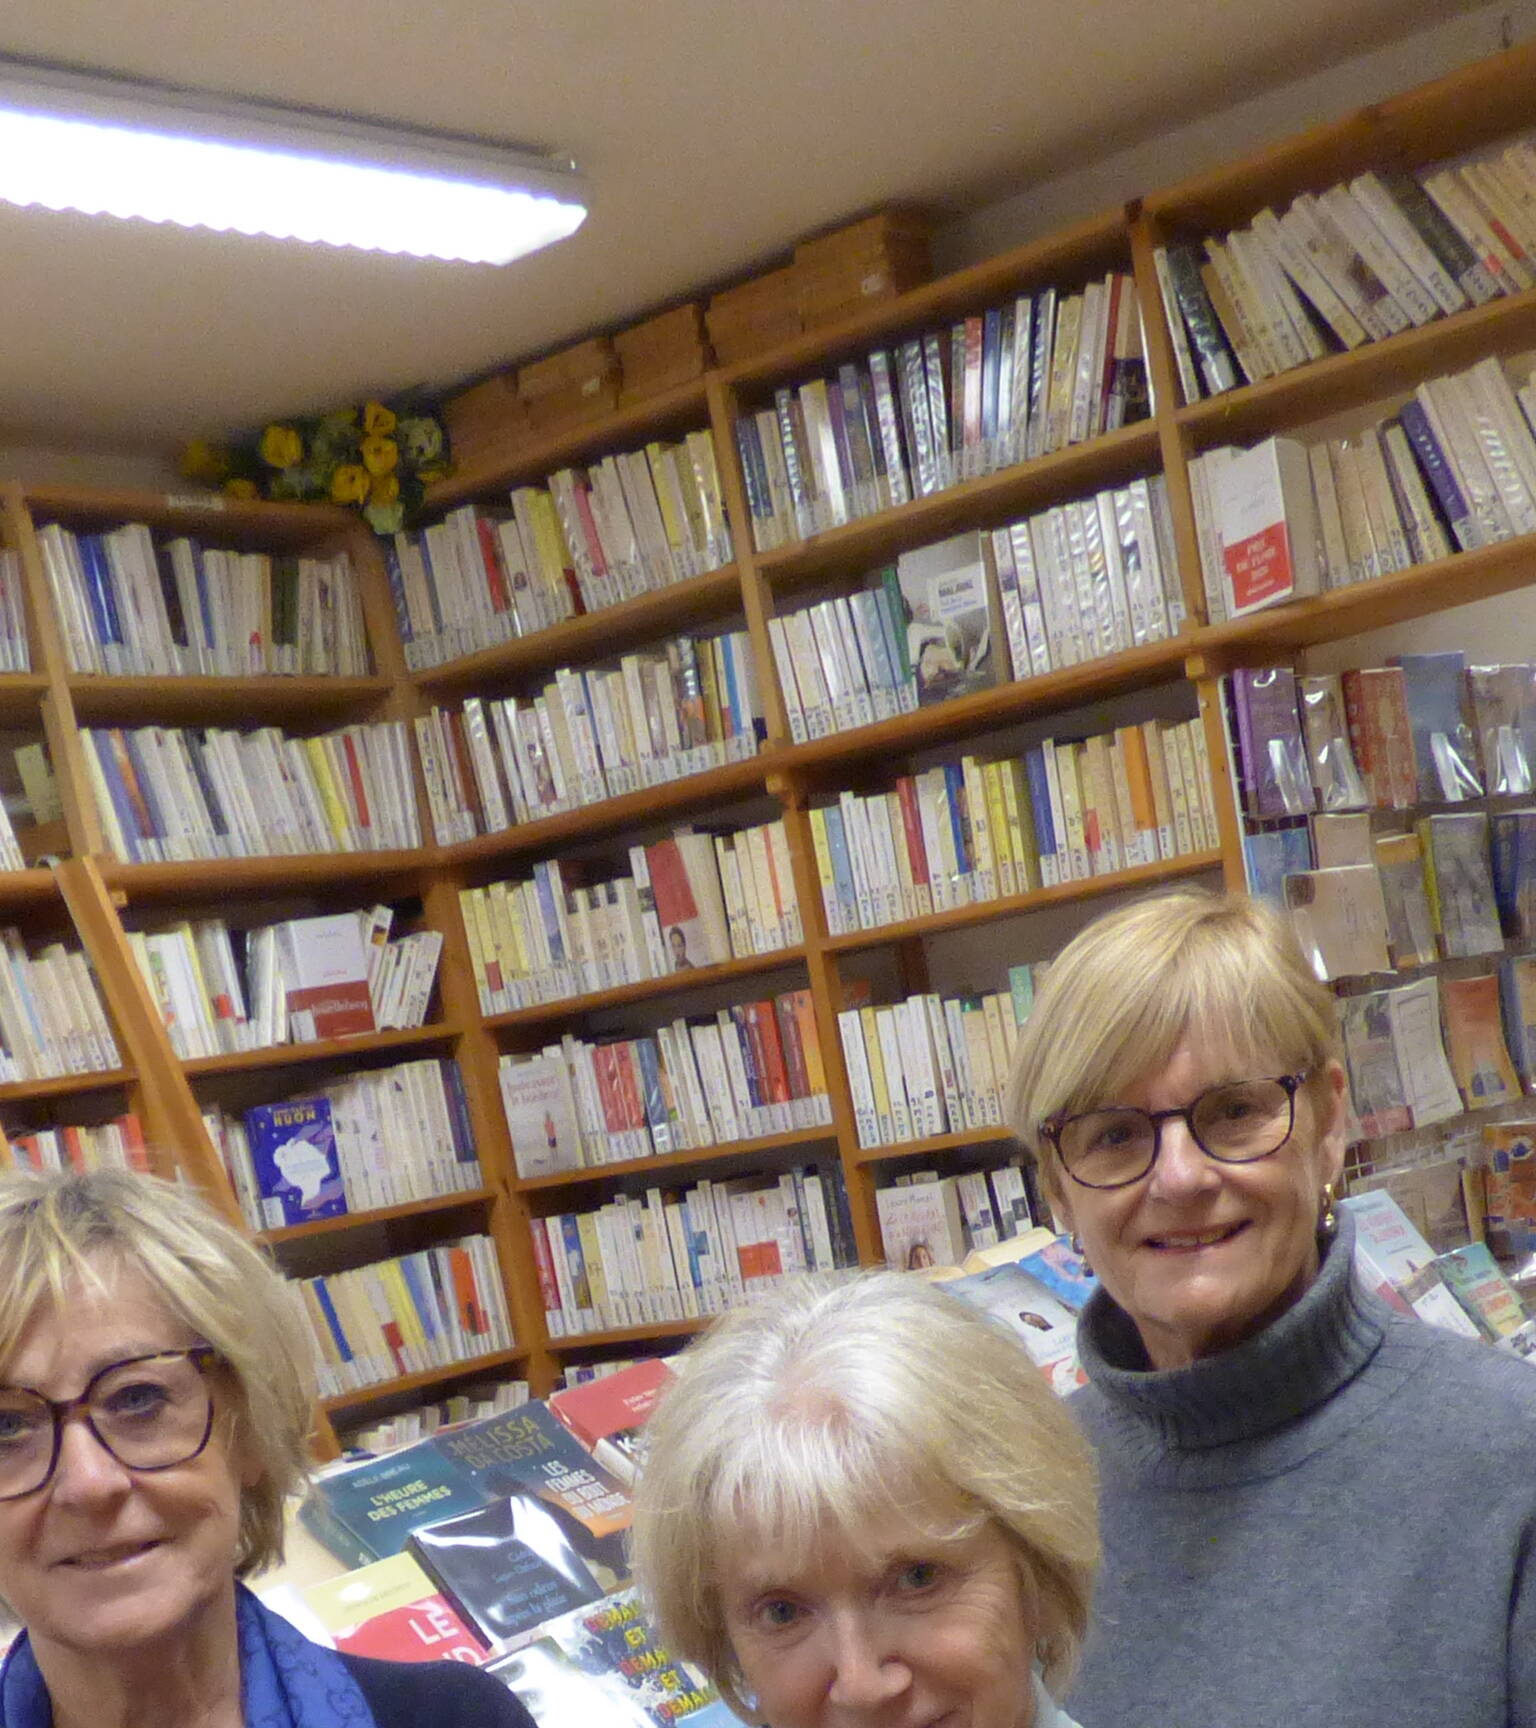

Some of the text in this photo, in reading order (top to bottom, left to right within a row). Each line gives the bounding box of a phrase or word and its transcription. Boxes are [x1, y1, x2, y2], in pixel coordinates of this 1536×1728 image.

[366, 1484, 453, 1523] DES FEMMES
[369, 1478, 427, 1507] L'HEURE
[407, 1608, 460, 1646] LE
[624, 1625, 646, 1649] ET
[660, 1668, 682, 1692] ET
